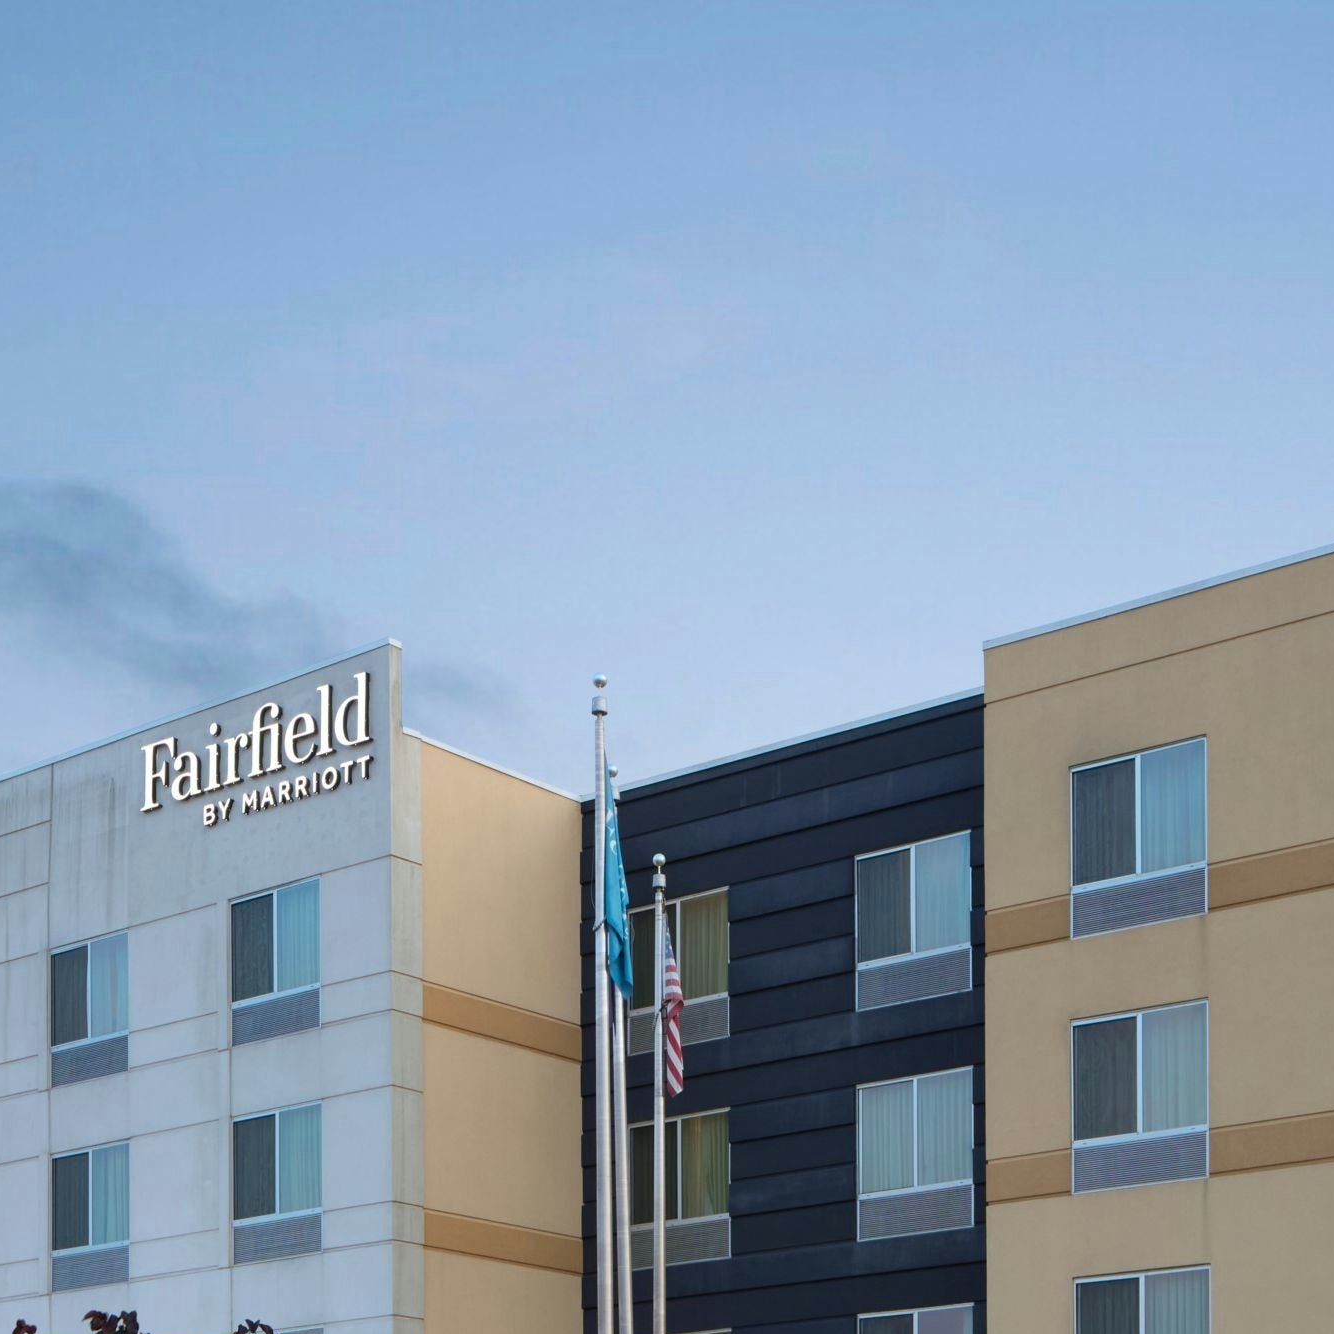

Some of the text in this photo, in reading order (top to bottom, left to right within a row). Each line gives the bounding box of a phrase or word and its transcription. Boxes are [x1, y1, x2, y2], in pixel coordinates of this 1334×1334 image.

[140, 671, 371, 813] Fairfield
[203, 754, 374, 827] BY MARRIOTT
